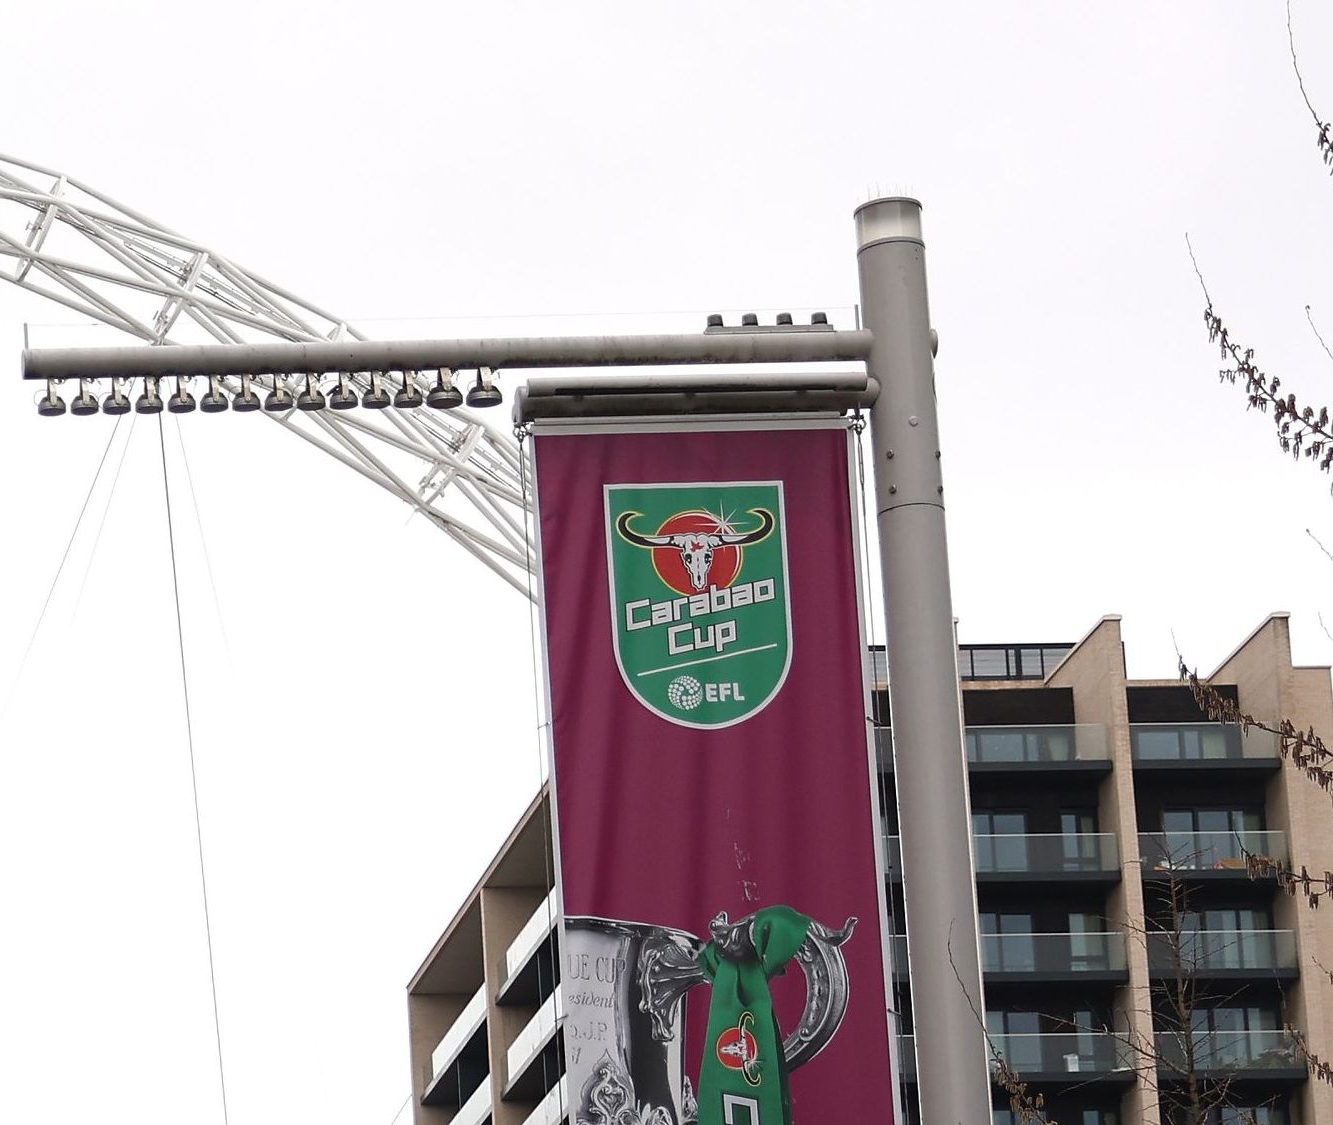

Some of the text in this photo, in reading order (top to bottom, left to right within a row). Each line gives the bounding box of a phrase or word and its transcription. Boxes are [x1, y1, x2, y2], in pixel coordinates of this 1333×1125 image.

[625, 577, 776, 632] Carabao
[668, 620, 737, 655] Cup
[705, 683, 745, 702] EFL
